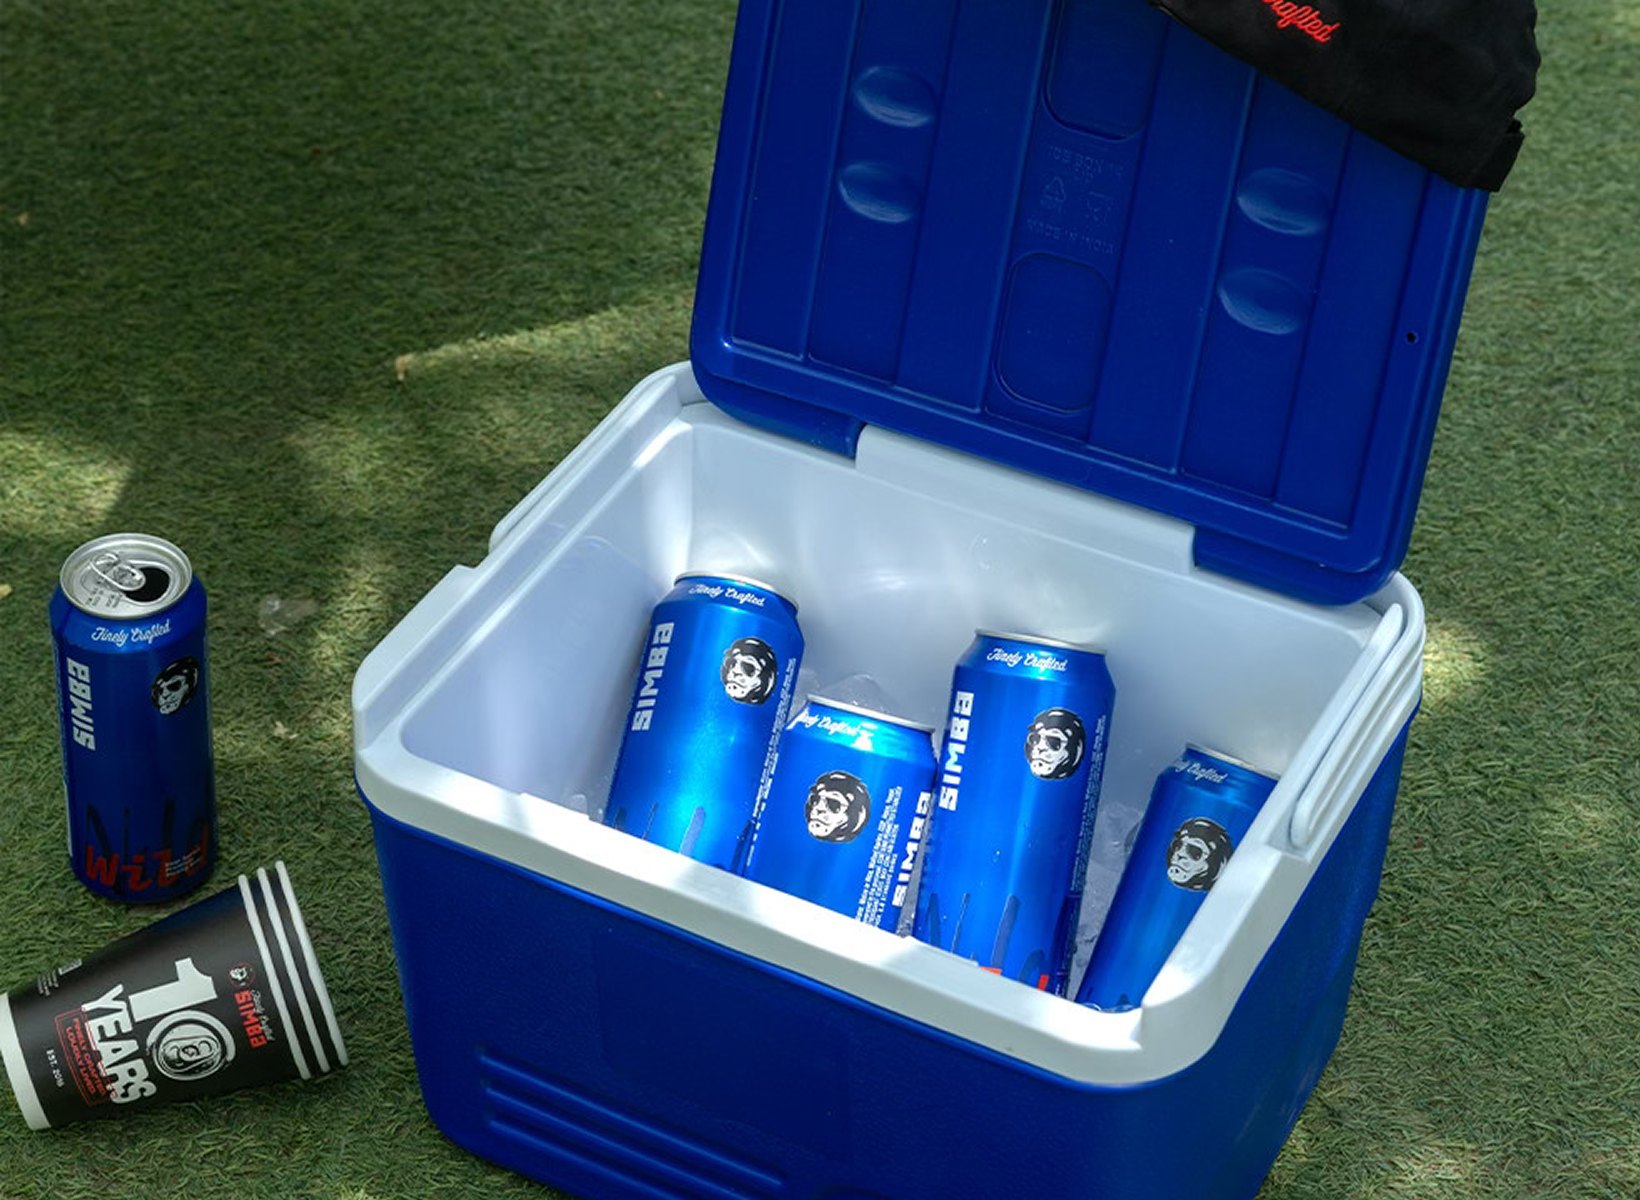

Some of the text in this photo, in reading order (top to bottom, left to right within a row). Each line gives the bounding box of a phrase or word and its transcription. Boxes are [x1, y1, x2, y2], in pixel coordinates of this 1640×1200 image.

[1263, 0, 1340, 42] rafted
[724, 587, 767, 607] Crafted
[91, 618, 171, 647] Finely Crafted
[986, 647, 1069, 673] Finely Crafted
[66, 656, 96, 751] SIMBA
[631, 622, 675, 731] SIMBA
[938, 690, 975, 812] SIMBA
[81, 984, 157, 1104] YEARS
[234, 989, 268, 1050] SIMBA
